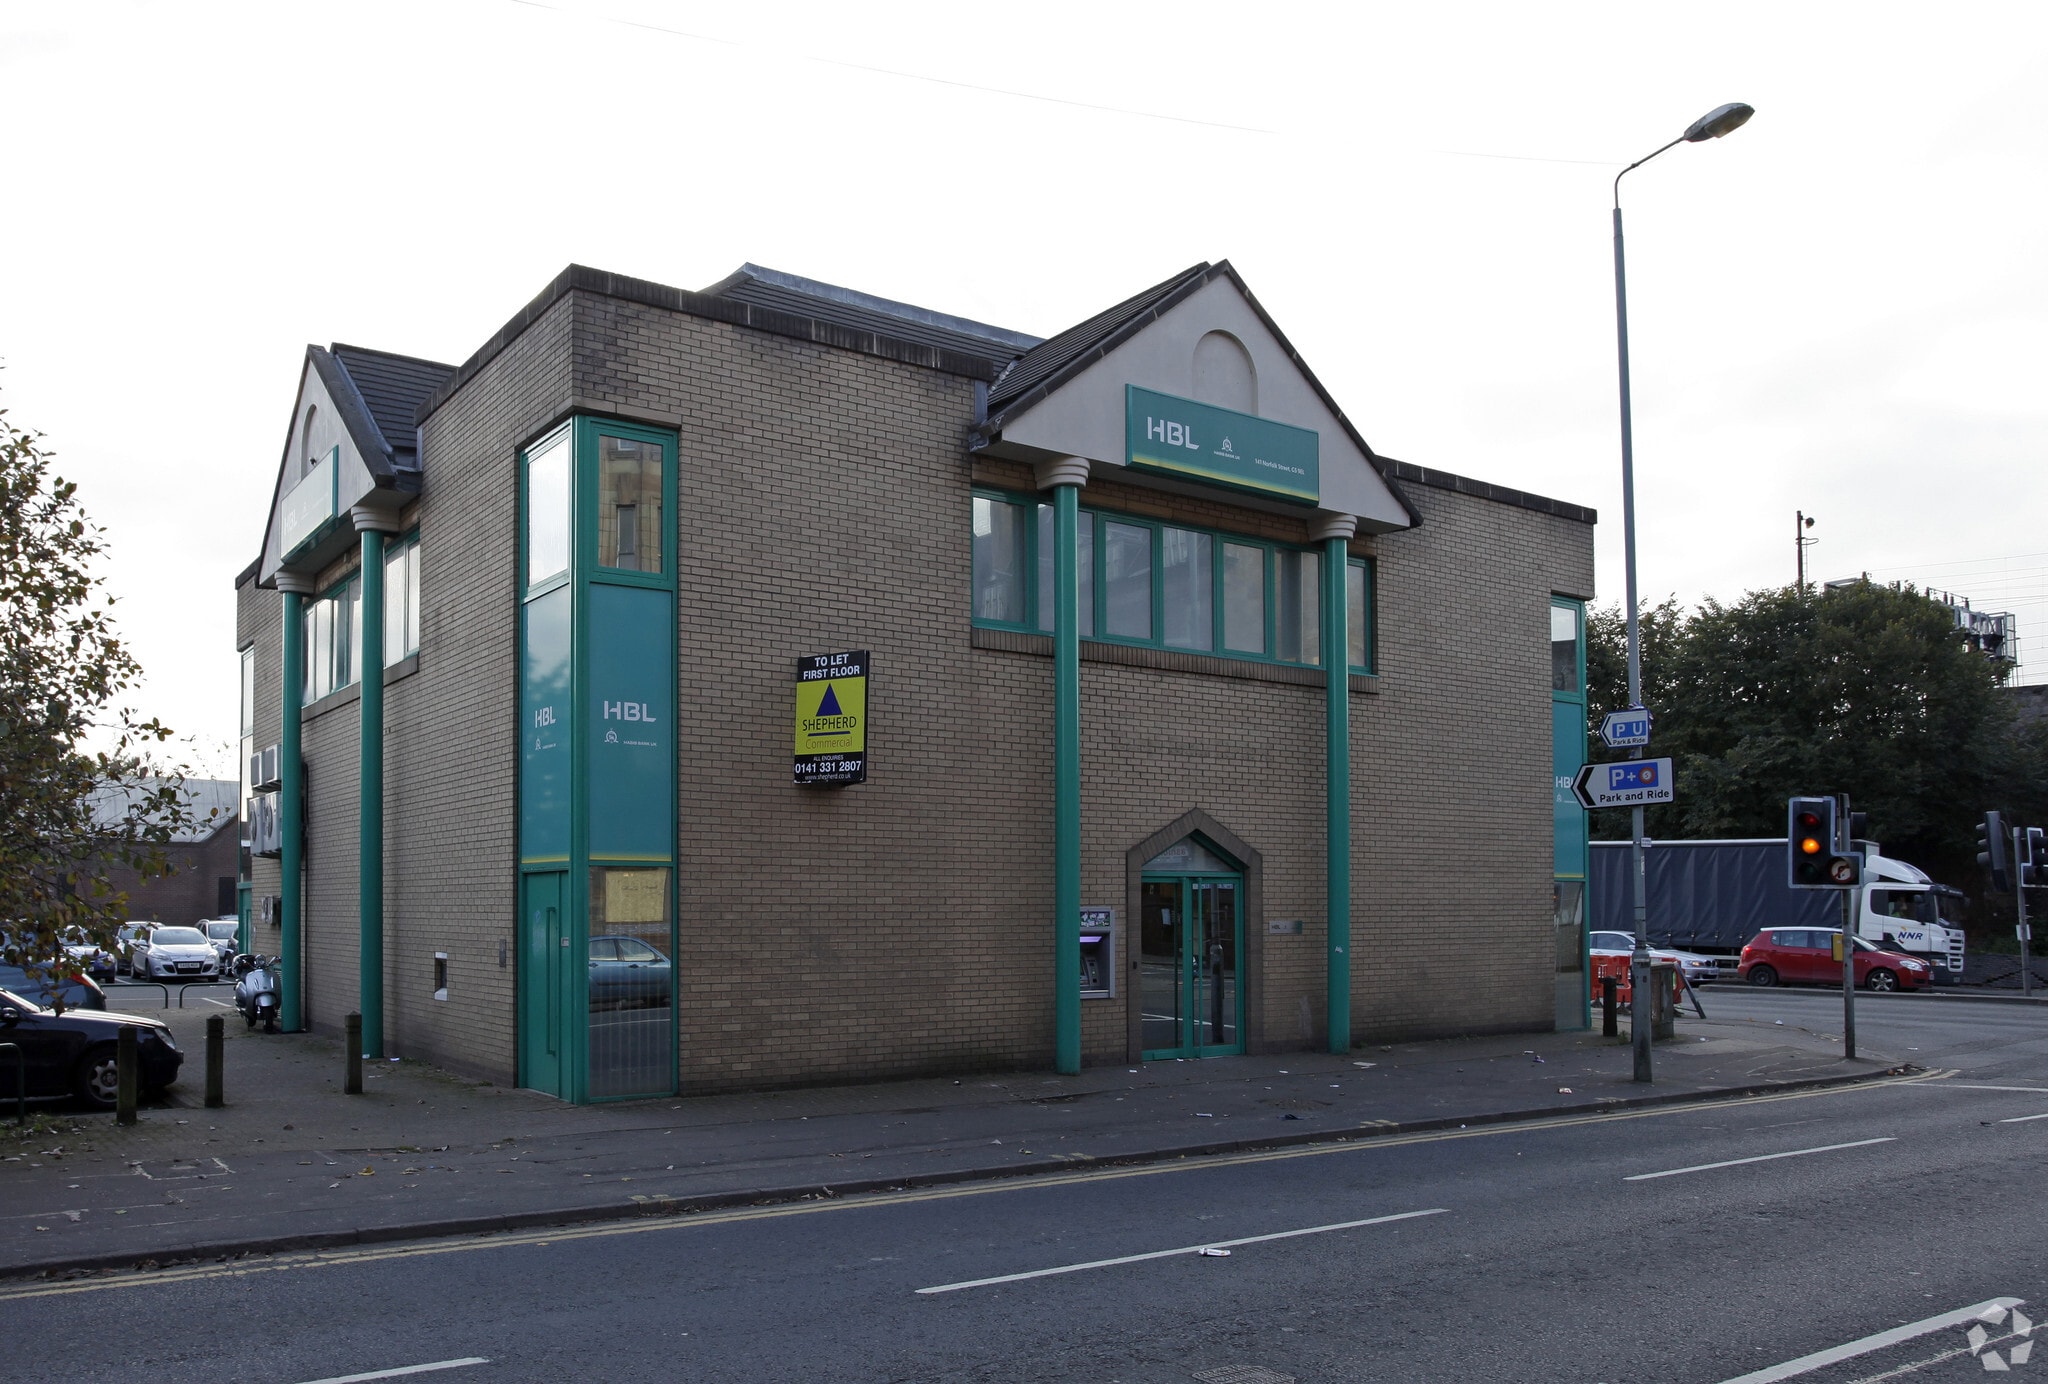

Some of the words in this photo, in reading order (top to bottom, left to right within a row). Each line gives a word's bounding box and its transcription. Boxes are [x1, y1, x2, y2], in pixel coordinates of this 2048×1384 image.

[1147, 416, 1199, 450] HBL
[1262, 460, 1277, 469] Norfolk
[814, 656, 828, 667] TO
[830, 654, 849, 666] LET
[803, 669, 828, 680] FIRST
[830, 665, 860, 677] FLOOR
[534, 705, 556, 728] HBL
[603, 700, 657, 723] HBL
[802, 716, 857, 732] SHEPHERD
[1616, 724, 1625, 737] P
[1632, 722, 1643, 735] U
[805, 737, 852, 750] Commercial
[795, 762, 816, 773] 0141
[819, 761, 836, 772] 331
[839, 760, 862, 771] 2807
[1599, 793, 1622, 802] Park
[1625, 791, 1643, 801] and
[1647, 789, 1670, 799] Ride
[1898, 931, 1923, 941] NNR
